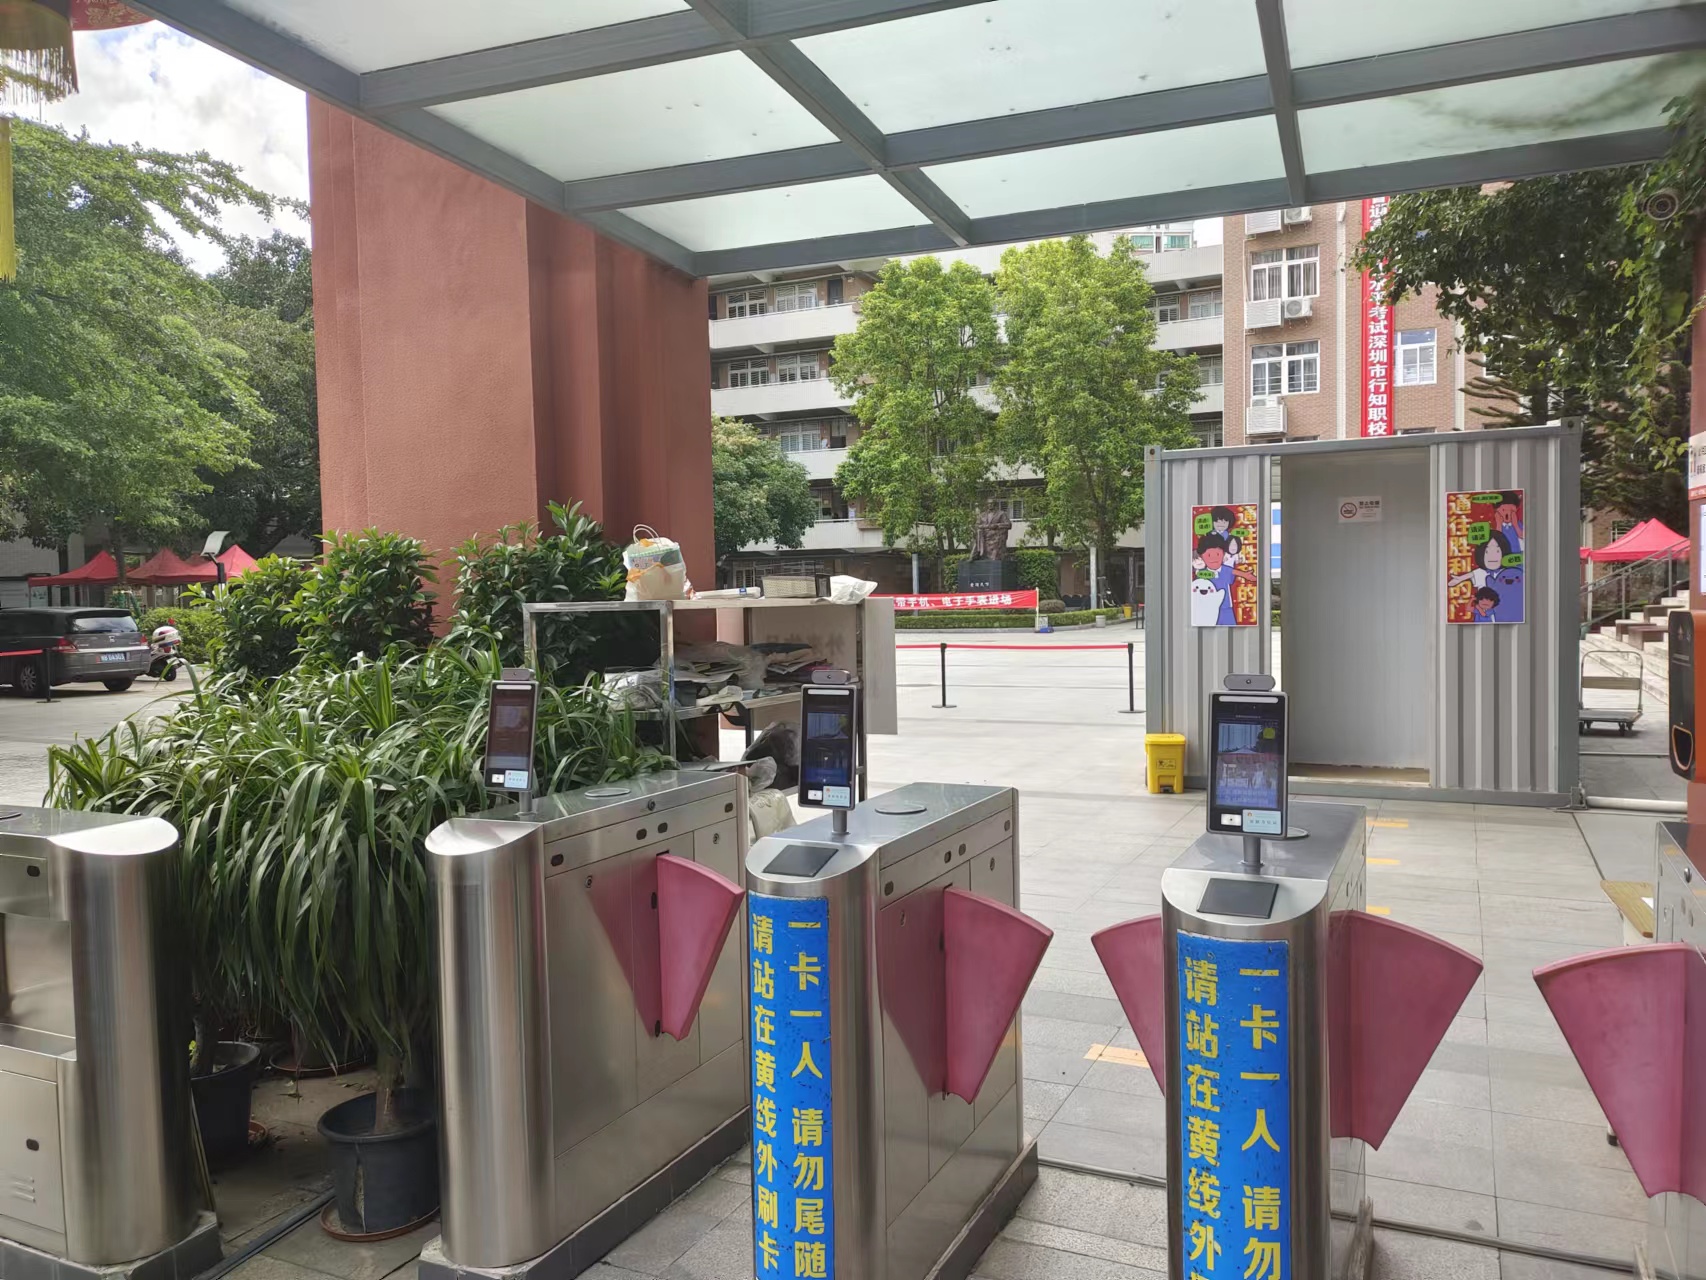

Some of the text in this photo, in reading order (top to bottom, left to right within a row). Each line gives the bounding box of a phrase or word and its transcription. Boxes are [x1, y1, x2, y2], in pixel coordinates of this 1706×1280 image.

[894, 594, 1012, 608] 带手机、电子手表进场
[751, 913, 781, 1270] 请站在黄线外刷卡
[788, 921, 823, 1079] 一卡一人
[1239, 967, 1281, 1152] 一卡一人
[1184, 956, 1222, 1280] 请站在黄线外
